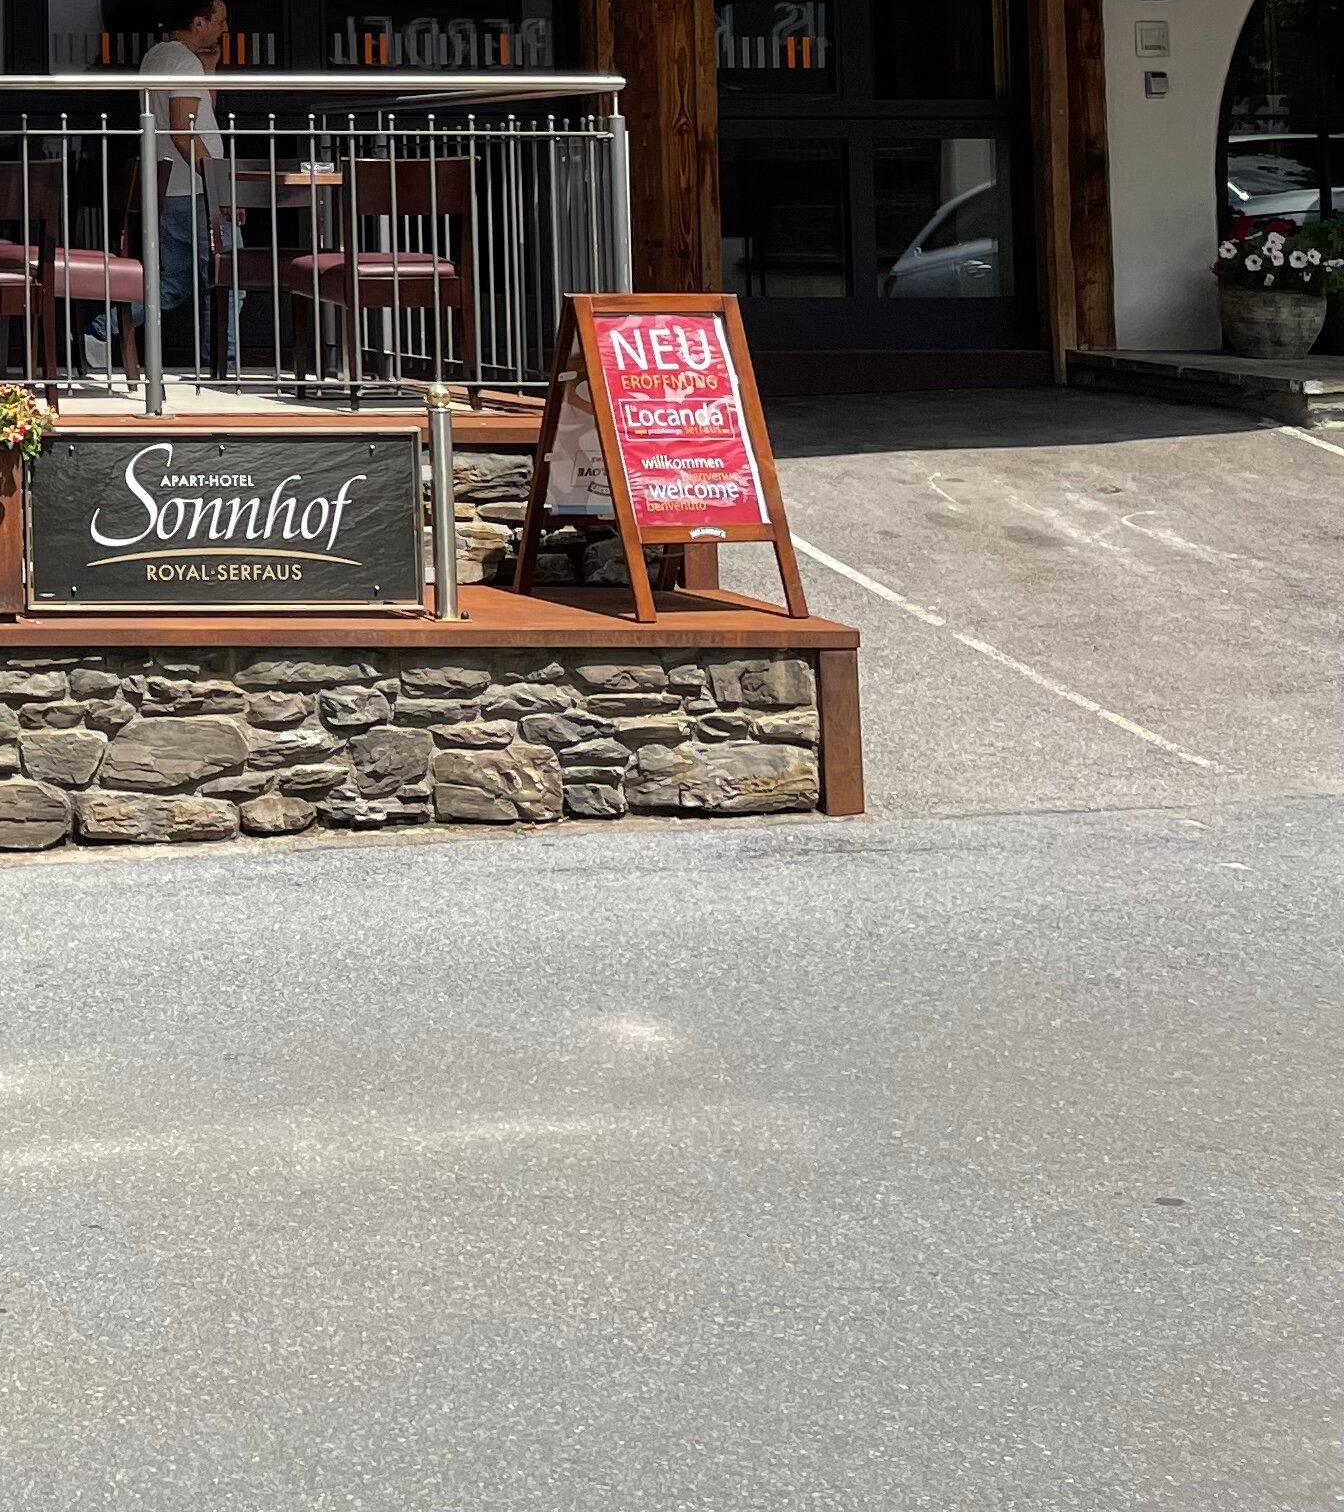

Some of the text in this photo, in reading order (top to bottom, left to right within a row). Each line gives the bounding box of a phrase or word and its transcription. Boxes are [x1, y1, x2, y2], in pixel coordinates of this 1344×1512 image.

[608, 325, 712, 371] NEU
[620, 372, 719, 390] ERÖFFNUNG
[624, 402, 724, 427] Locanda
[641, 454, 725, 470] willkommen
[159, 473, 255, 488] APART-HOTEL
[648, 478, 740, 500] welcome
[89, 442, 368, 552] Sonnhof
[646, 499, 708, 513] benvenuto
